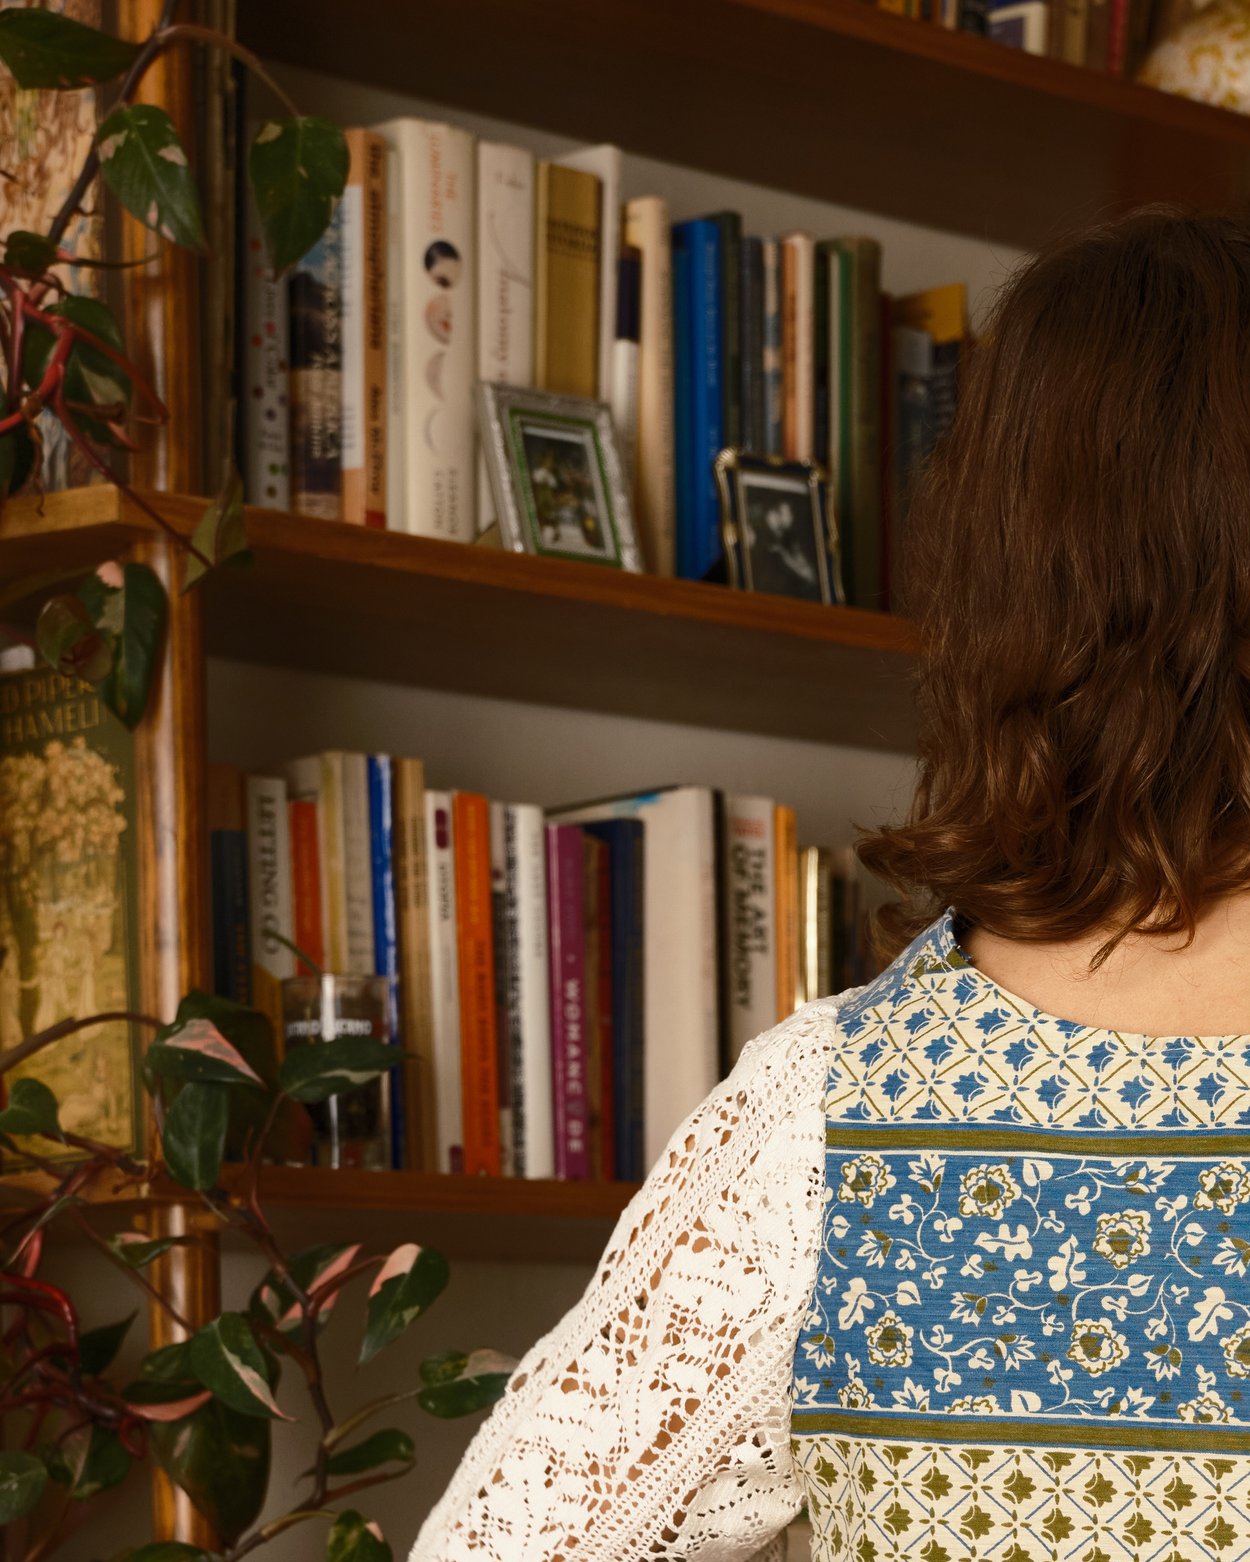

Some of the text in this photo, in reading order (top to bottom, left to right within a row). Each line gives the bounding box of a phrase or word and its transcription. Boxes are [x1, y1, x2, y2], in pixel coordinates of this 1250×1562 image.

[257, 794, 279, 906] LETTING
[731, 843, 750, 882] OF
[750, 848, 770, 955] THE ART
[732, 888, 753, 1010] MEMORY
